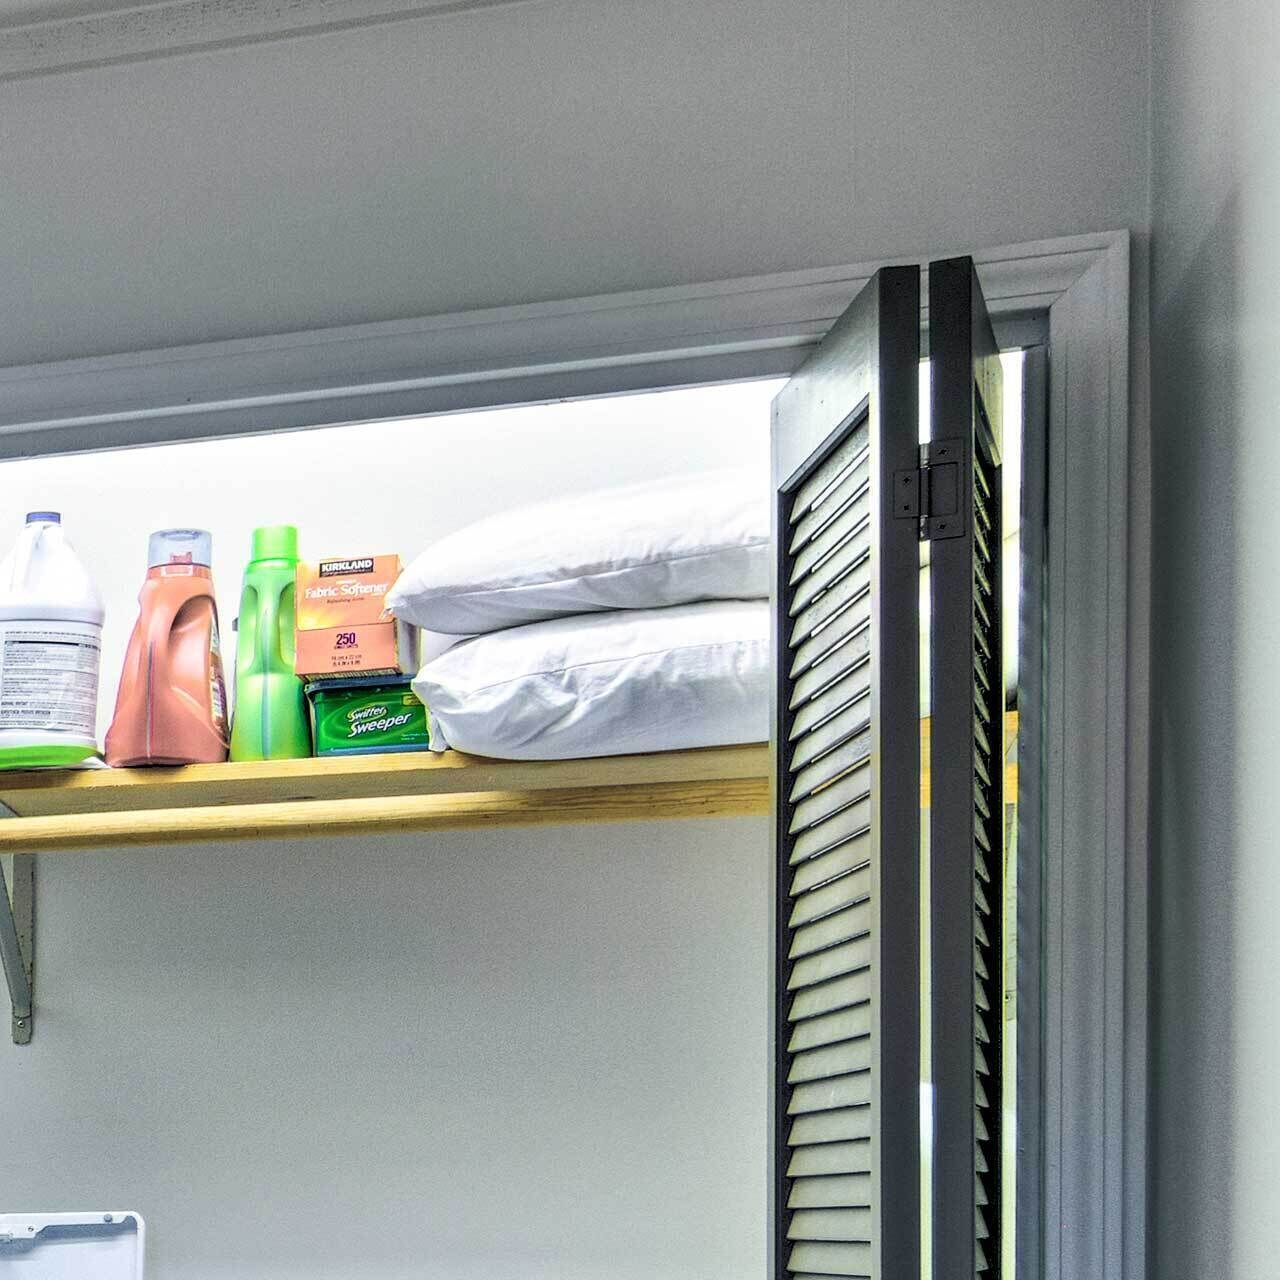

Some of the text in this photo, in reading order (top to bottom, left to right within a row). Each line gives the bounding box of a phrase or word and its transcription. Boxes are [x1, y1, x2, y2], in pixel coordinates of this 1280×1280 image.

[321, 559, 373, 572] KIRKLAND
[305, 582, 389, 599] Fabric Softener
[336, 632, 356, 646] 250
[348, 705, 385, 722] Swiffer
[347, 713, 412, 738] Sweeper
